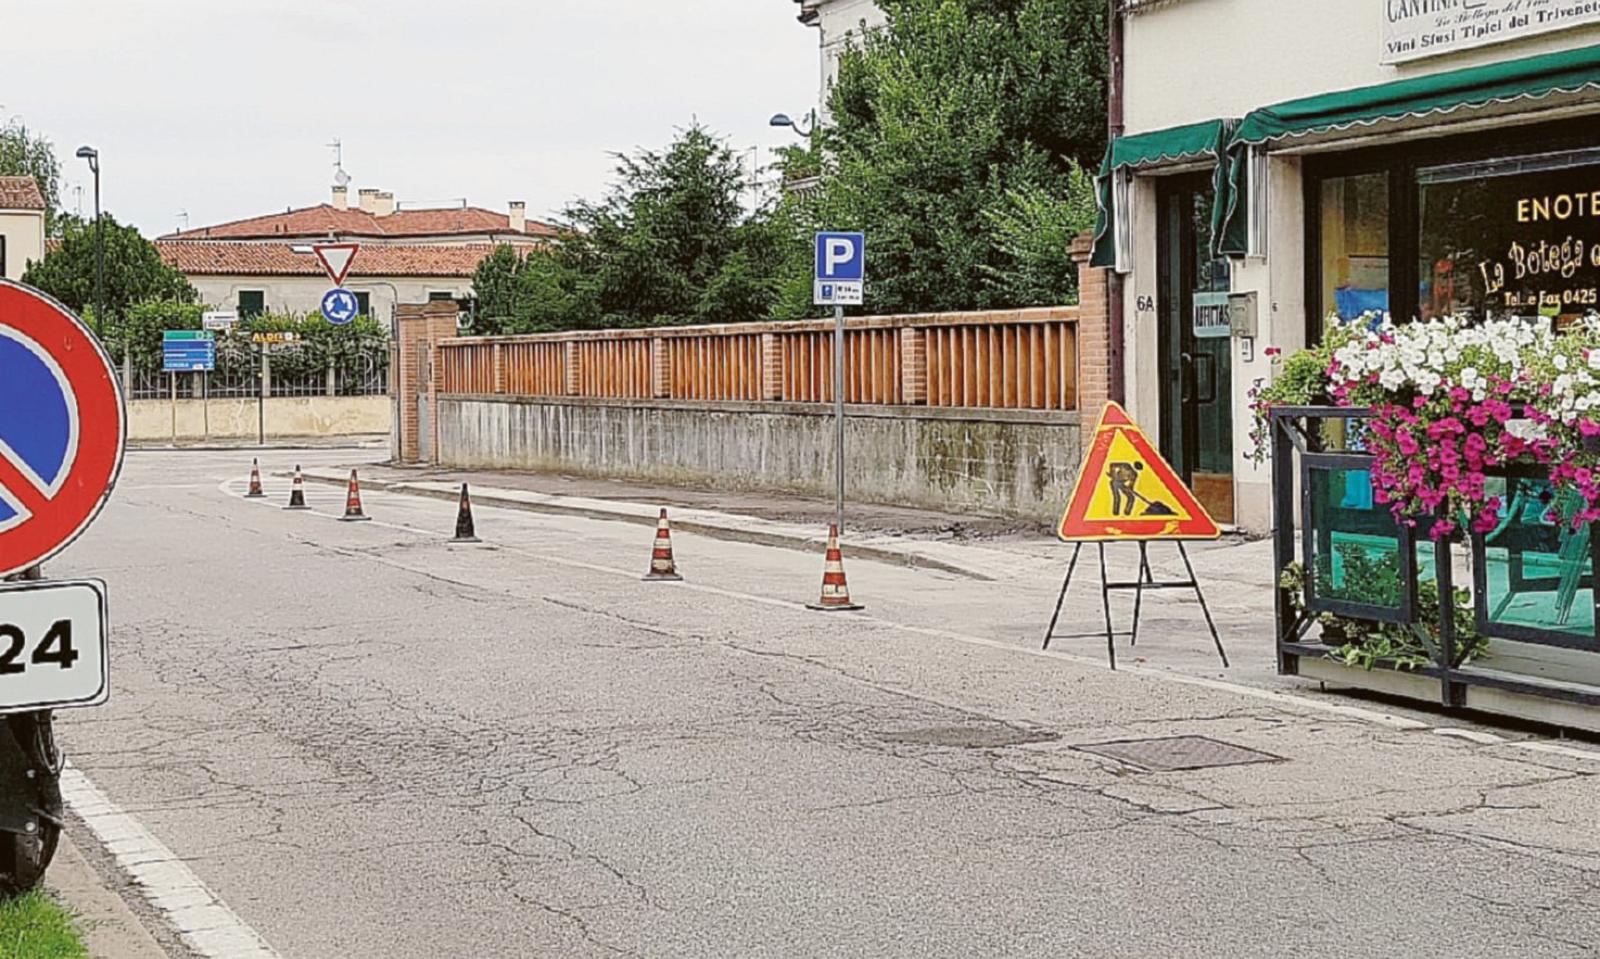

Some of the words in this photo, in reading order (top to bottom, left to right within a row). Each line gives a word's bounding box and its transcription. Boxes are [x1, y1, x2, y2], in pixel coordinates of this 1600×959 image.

[1387, 0, 1458, 23] CANT
[1387, 39, 1415, 53] Vini
[1421, 29, 1455, 48] Sfusi
[1460, 19, 1501, 38] Tipici
[1509, 14, 1529, 29] del
[1517, 191, 1600, 222] ENOTE
[825, 238, 854, 275] P
[1478, 259, 1504, 294] La
[1508, 235, 1584, 279] Botega
[1136, 295, 1155, 312] 6A
[1563, 288, 1597, 304] 0425
[0, 618, 79, 675] 24
